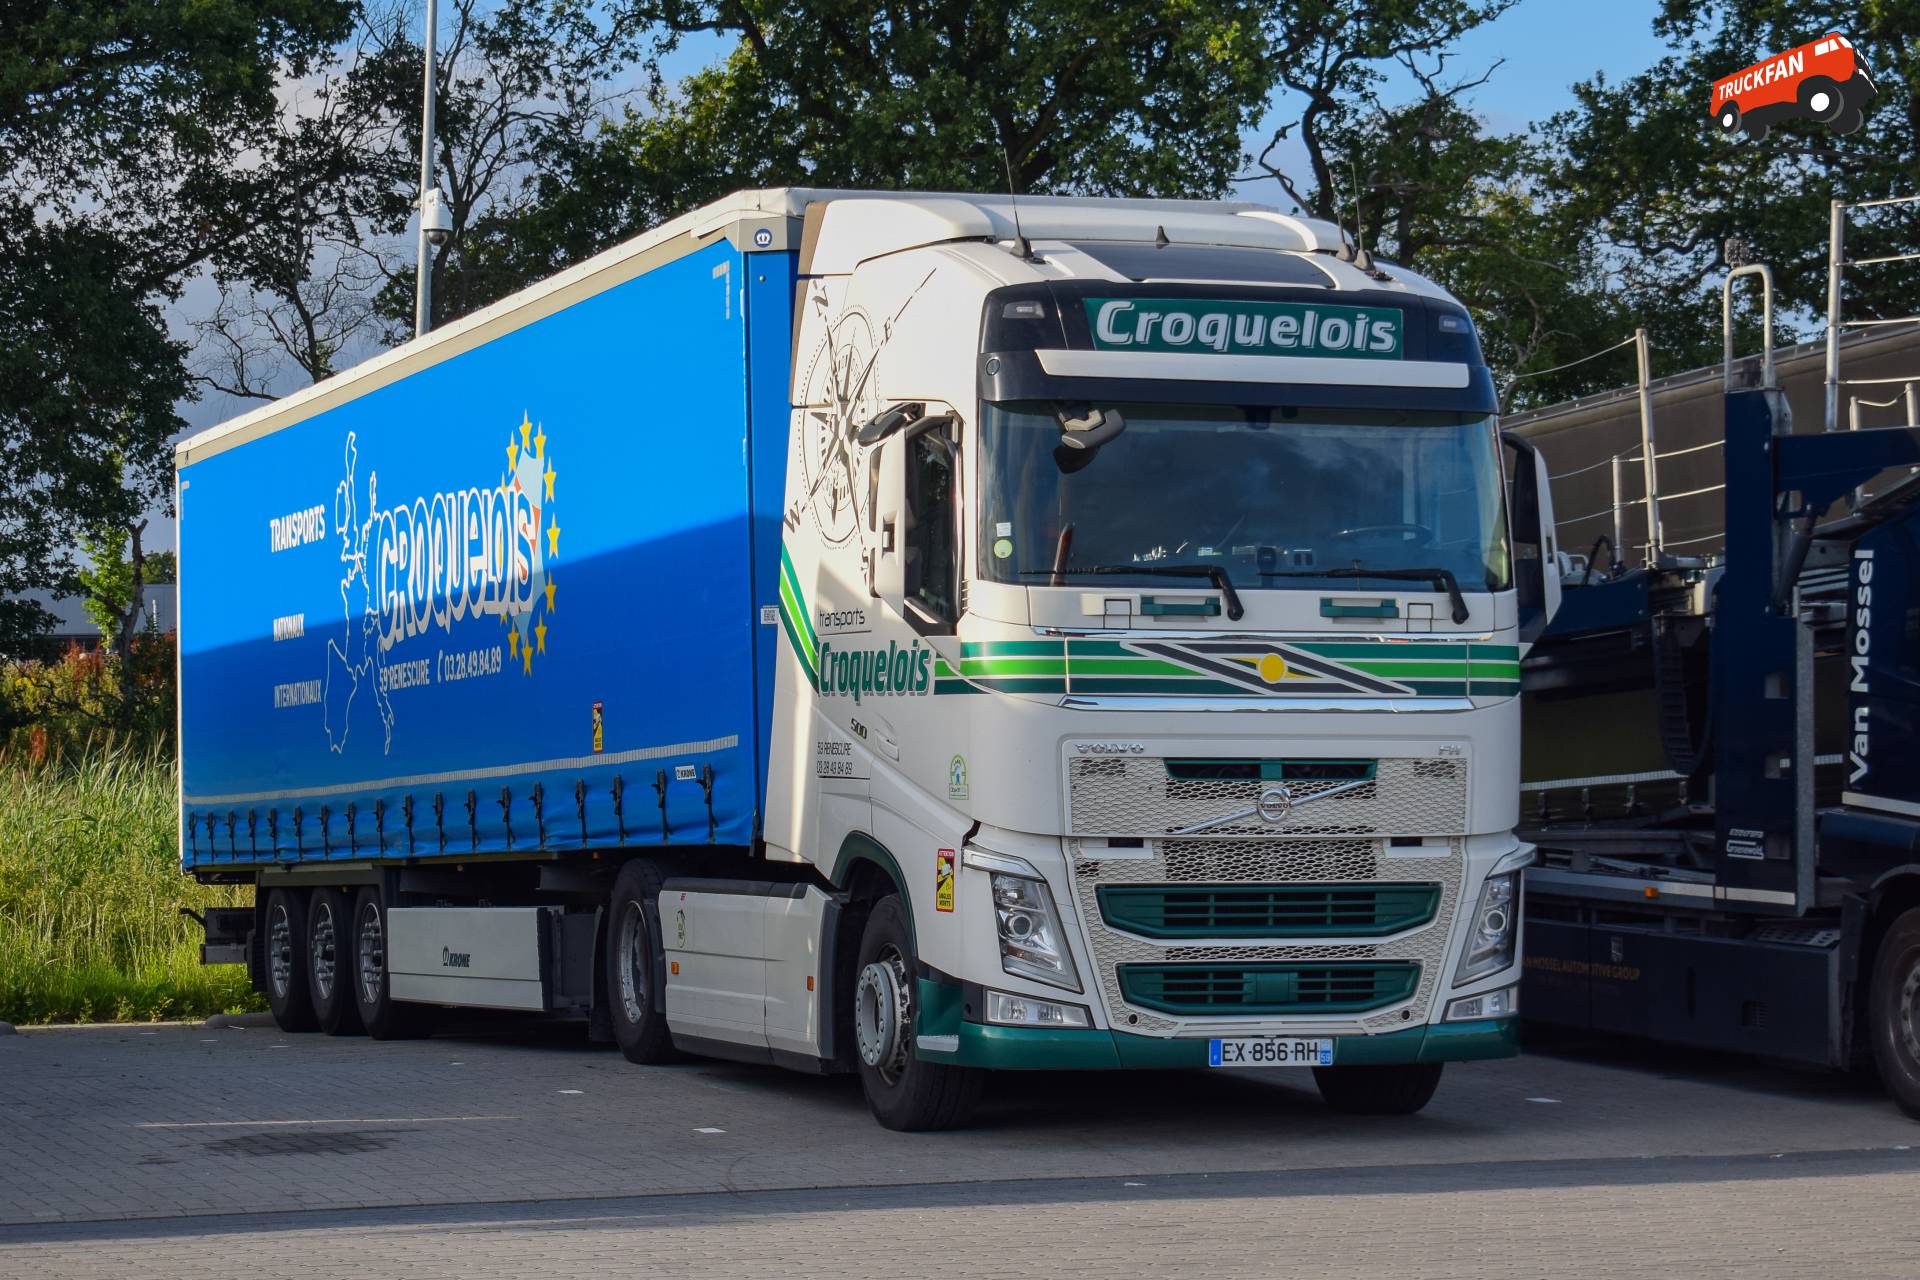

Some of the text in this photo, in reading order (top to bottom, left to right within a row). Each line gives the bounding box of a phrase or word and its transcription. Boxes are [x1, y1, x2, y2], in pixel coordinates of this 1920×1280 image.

[1096, 301, 1396, 352] Croquelois
[270, 504, 325, 553] TRANSPORTS
[273, 613, 305, 641] NATIONAUX
[819, 608, 866, 629] transports
[389, 659, 430, 690] RENESCURE
[444, 645, 502, 681] 03.28.49.84.89
[820, 639, 931, 705] Croquelois
[1850, 549, 1874, 784] Van Mossel
[274, 679, 322, 708] INTERNATIONAUX
[850, 717, 868, 740] 500
[1075, 743, 1145, 754] VOLVO
[448, 952, 471, 968] KRONE
